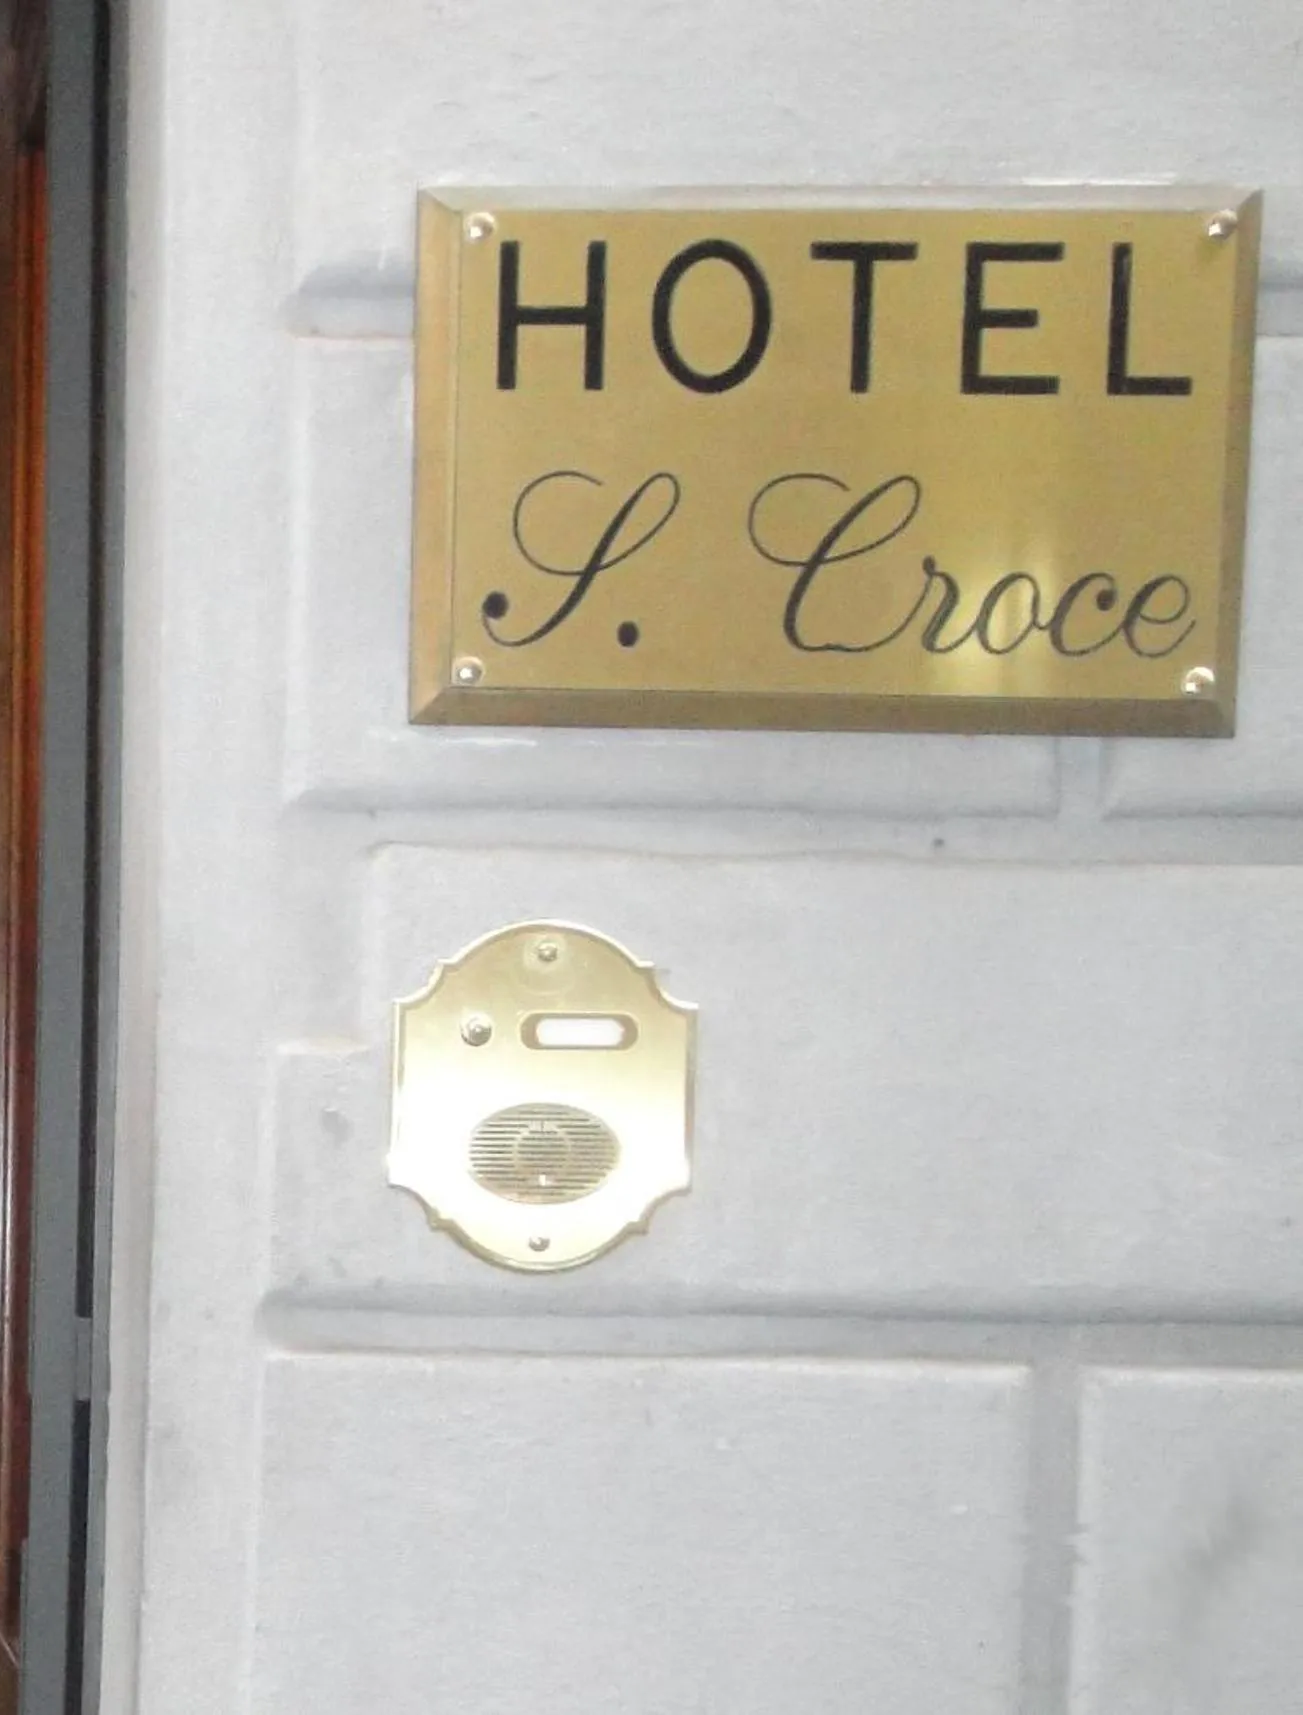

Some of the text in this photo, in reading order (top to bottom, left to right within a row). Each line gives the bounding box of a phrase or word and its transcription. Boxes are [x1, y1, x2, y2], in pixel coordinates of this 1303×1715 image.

[496, 238, 1194, 395] HOTEL
[481, 469, 1197, 658] S. Croce
